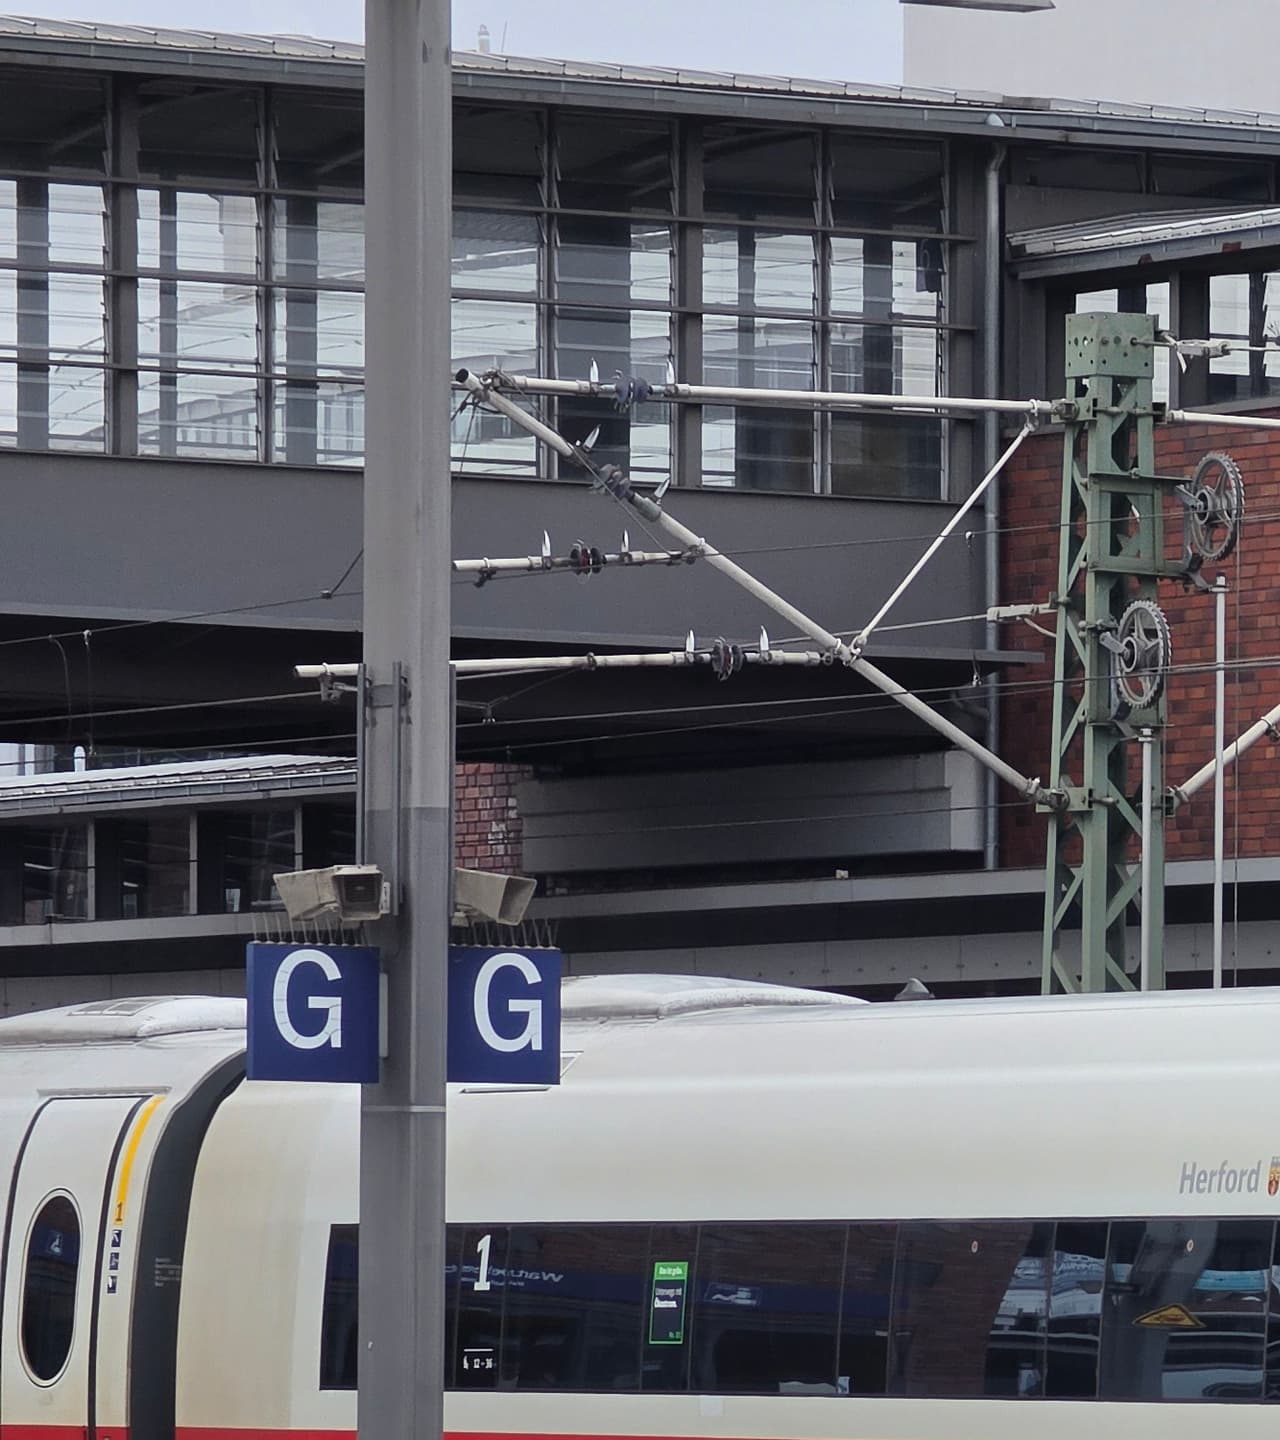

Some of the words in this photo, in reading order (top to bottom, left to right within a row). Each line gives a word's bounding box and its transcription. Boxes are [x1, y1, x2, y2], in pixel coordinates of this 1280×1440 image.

[273, 949, 343, 1049] G
[473, 952, 543, 1052] G
[1179, 1159, 1262, 1194] Herford
[114, 1202, 123, 1222] 1
[473, 1234, 492, 1291] 1
